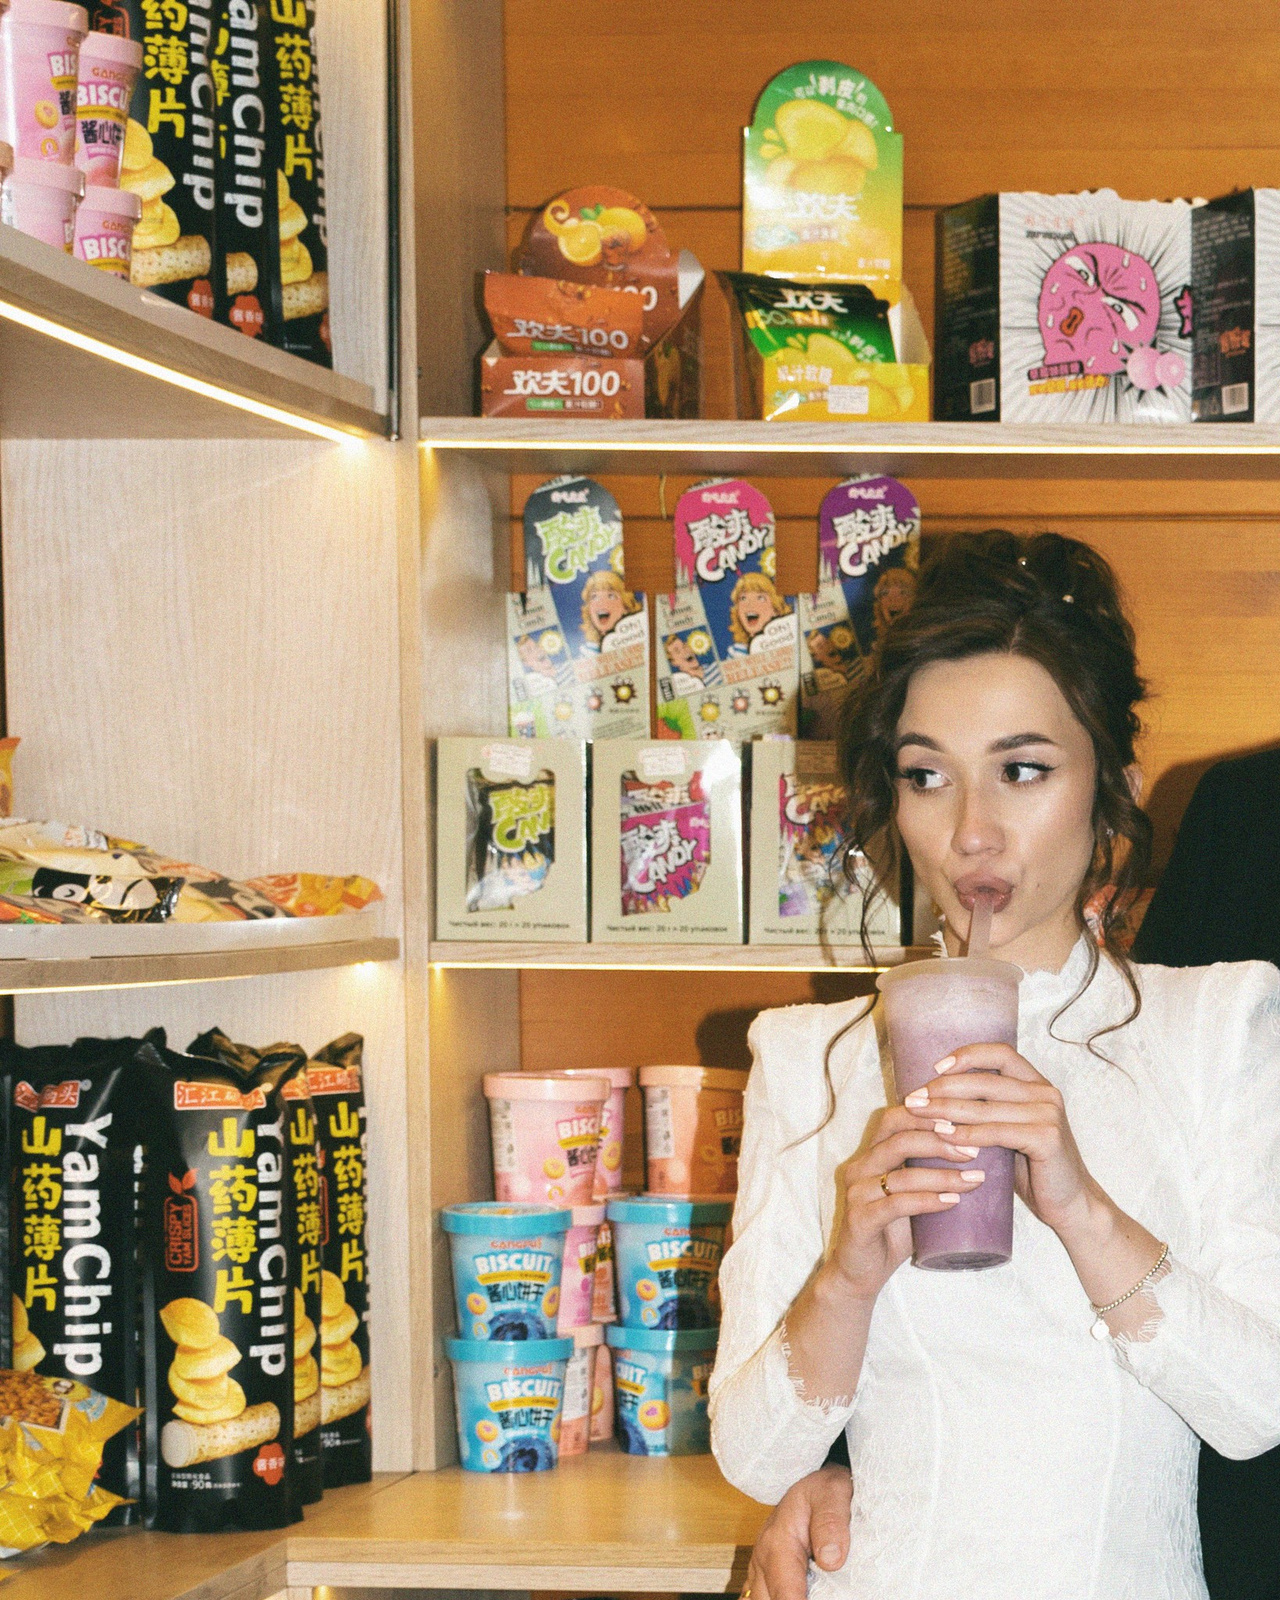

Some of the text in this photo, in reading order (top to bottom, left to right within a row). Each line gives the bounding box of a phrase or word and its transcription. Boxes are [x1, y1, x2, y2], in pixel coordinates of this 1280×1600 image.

[76, 81, 128, 107] BISCU
[81, 235, 130, 261] BISC
[493, 811, 555, 853] CAN
[328, 1100, 365, 1283] 山药薄片
[21, 1115, 62, 1313] 山药薄片
[207, 1116, 259, 1316] 山药薄片
[53, 1111, 114, 1377] YamChip
[646, 1240, 720, 1261] BISCUIT
[474, 1252, 554, 1275] BISCUIT
[486, 1379, 561, 1402] BISCUIT
